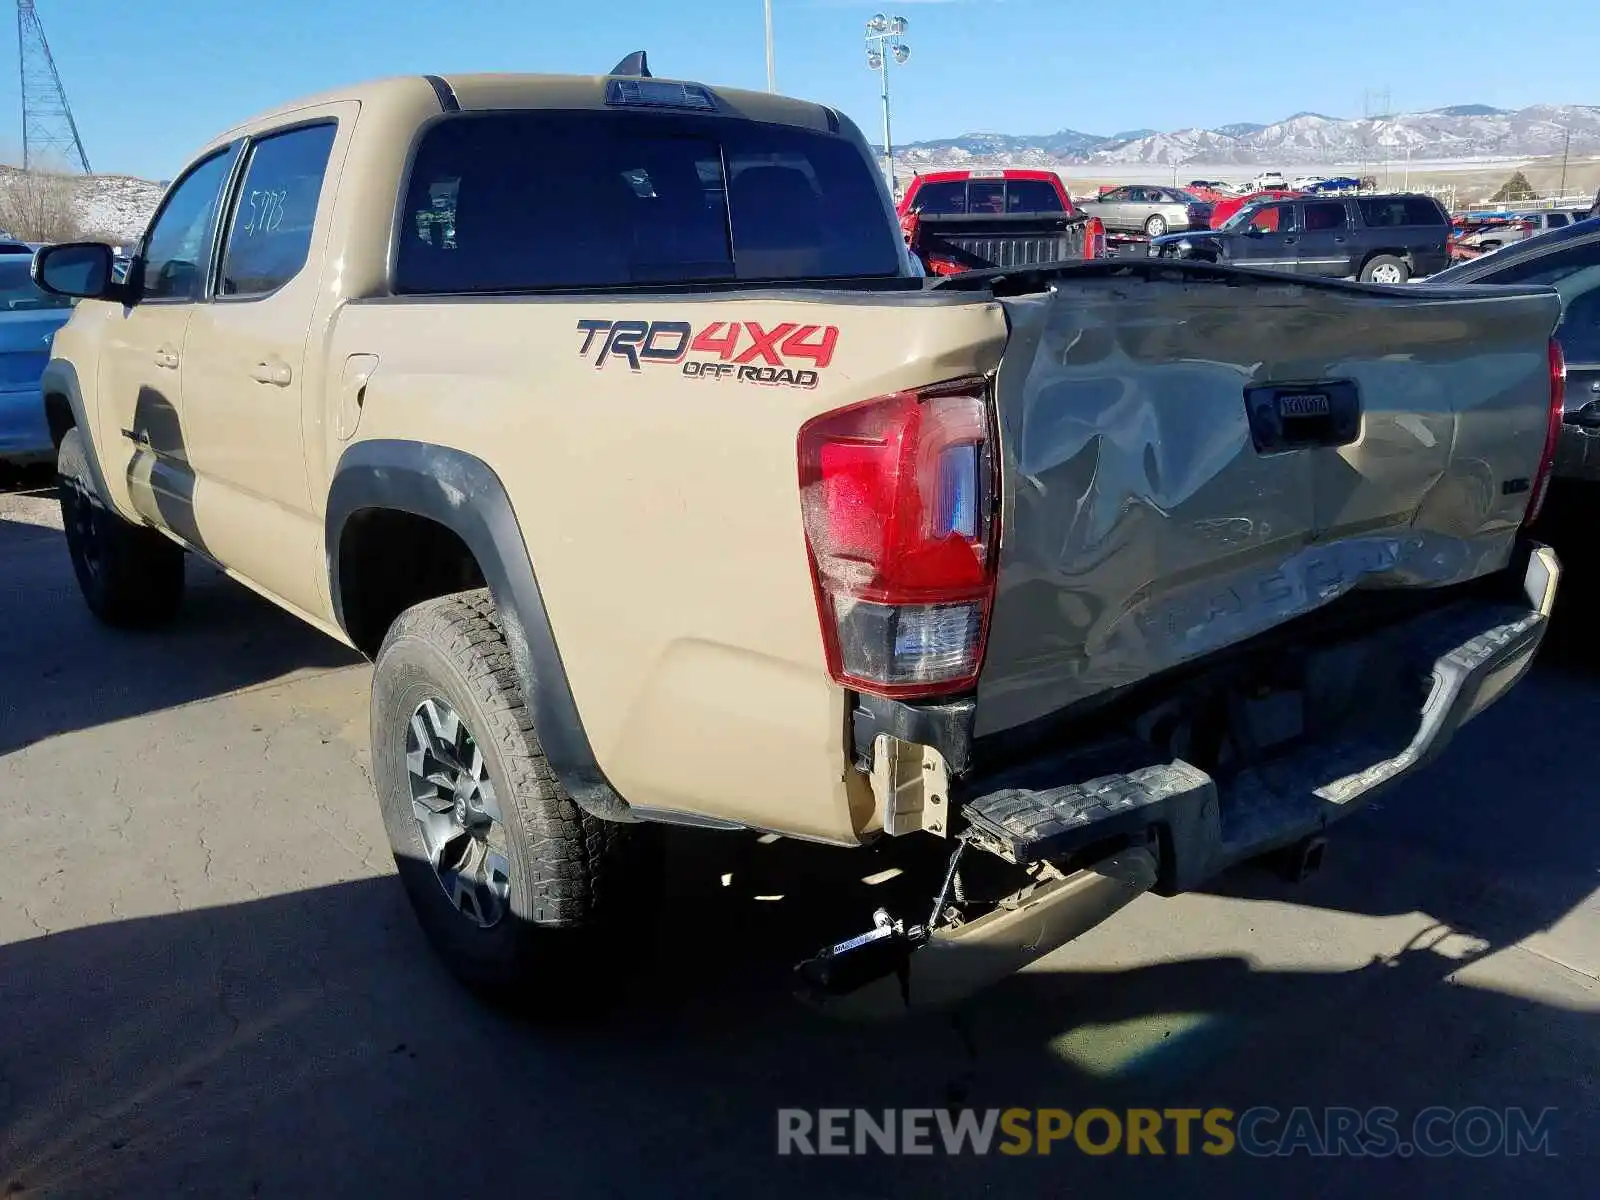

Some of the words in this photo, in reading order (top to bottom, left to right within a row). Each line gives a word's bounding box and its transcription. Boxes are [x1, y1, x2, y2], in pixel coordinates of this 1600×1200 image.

[576, 319, 692, 373] TRD
[691, 321, 839, 368] 4X4
[682, 361, 736, 381] OFF
[736, 364, 820, 390] ROAD
